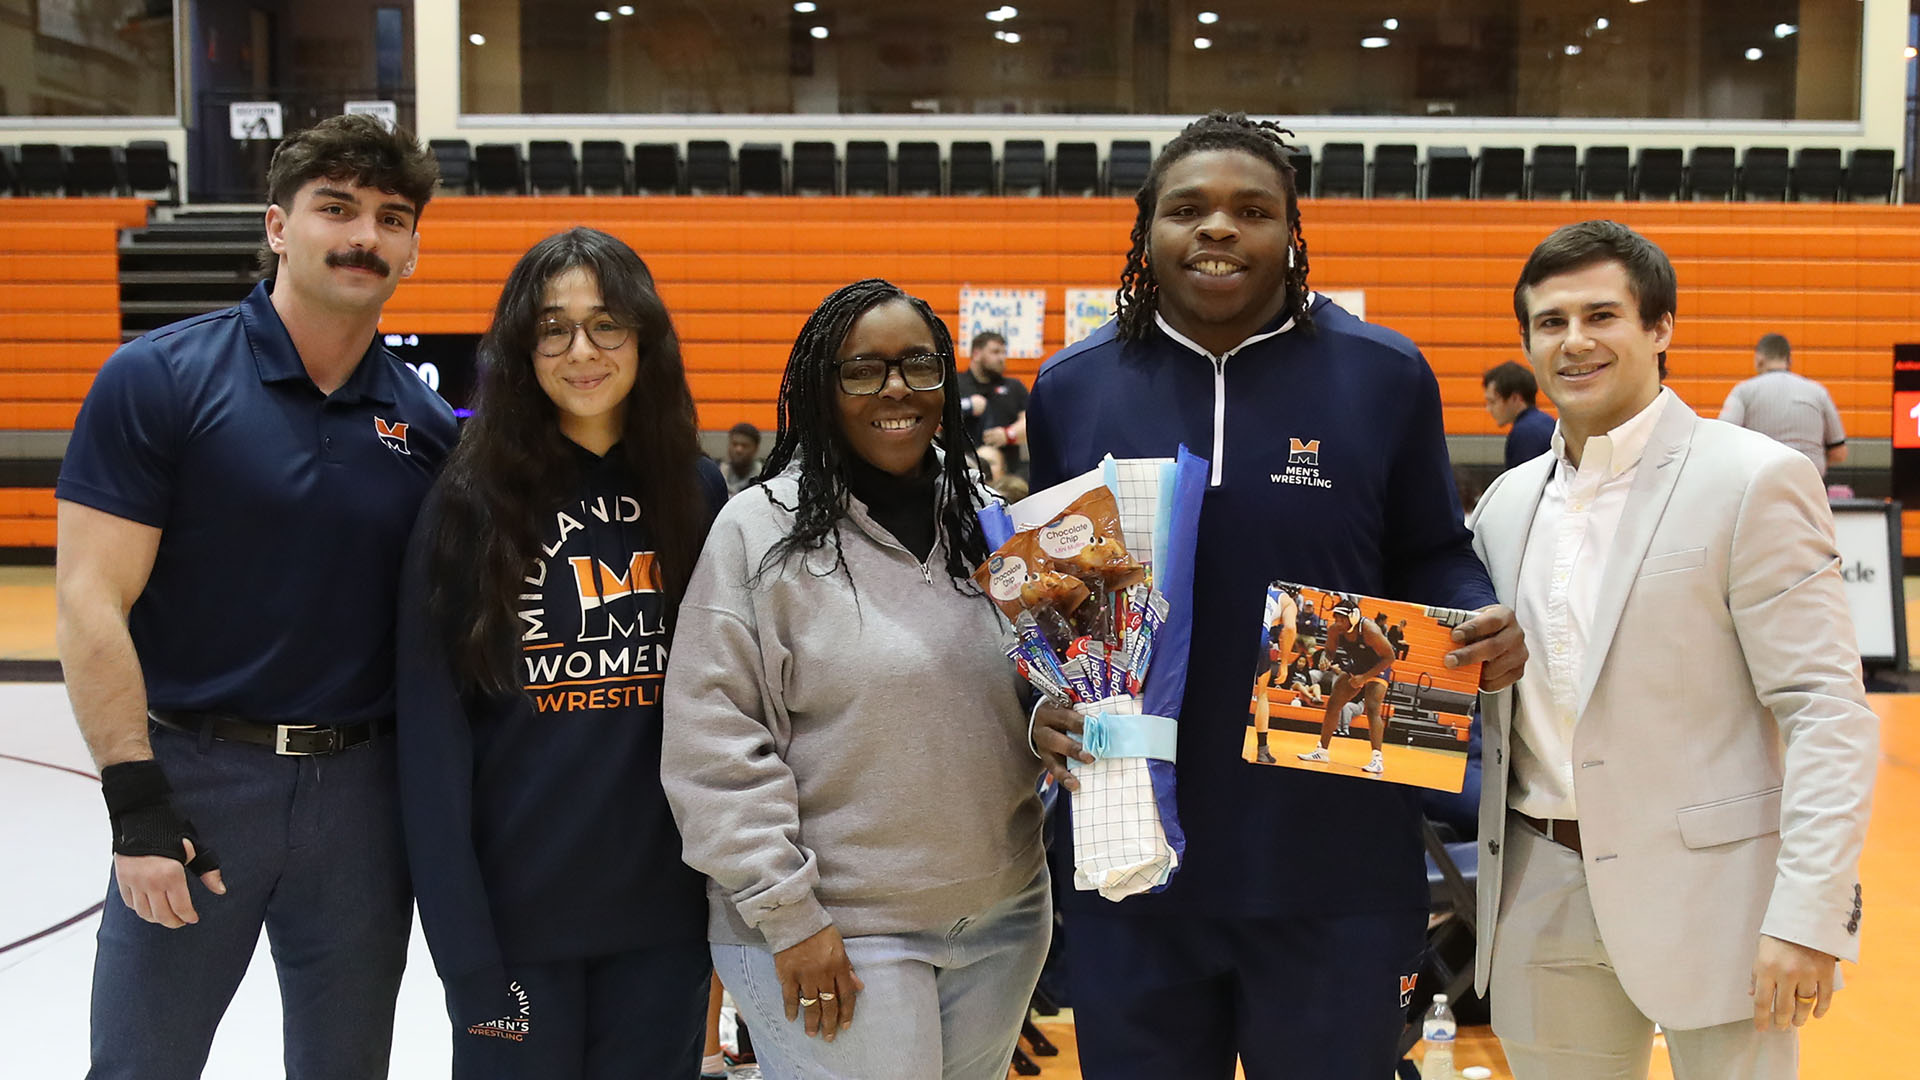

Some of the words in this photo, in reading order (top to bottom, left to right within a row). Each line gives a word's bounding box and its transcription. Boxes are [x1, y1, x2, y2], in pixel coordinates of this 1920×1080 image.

[1285, 466, 1320, 478] MEN'S
[1270, 474, 1332, 489] WRESTLING
[1046, 523, 1088, 540] Chocolate
[1059, 535, 1079, 545] Chip
[467, 1027, 524, 1042] WRESTLING
